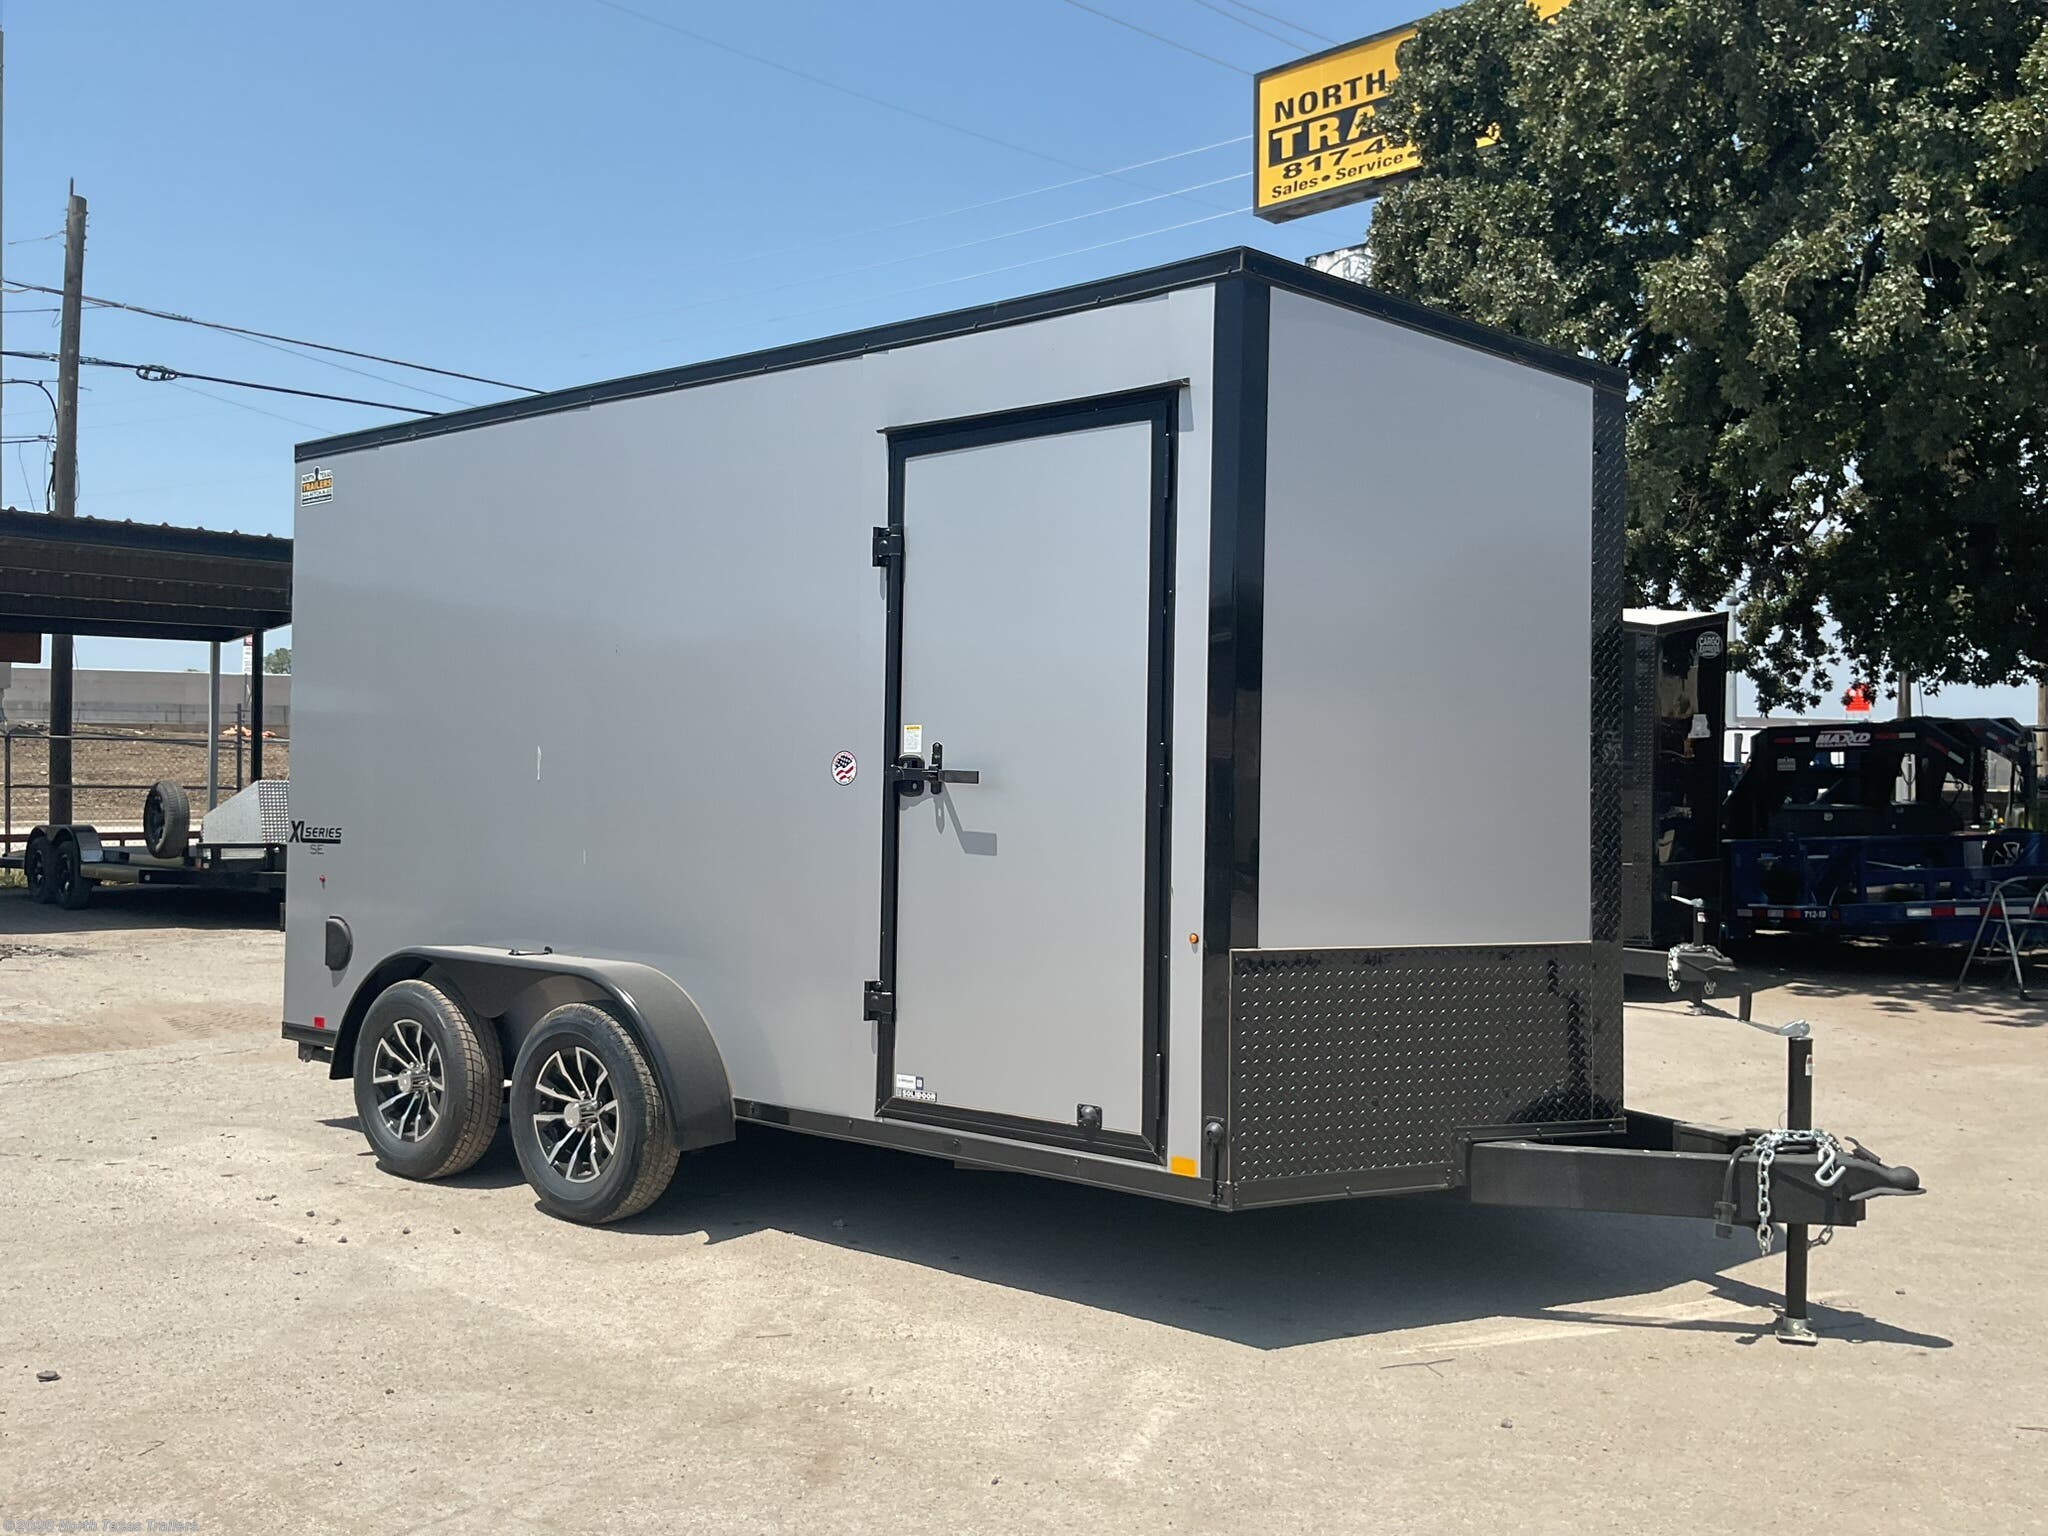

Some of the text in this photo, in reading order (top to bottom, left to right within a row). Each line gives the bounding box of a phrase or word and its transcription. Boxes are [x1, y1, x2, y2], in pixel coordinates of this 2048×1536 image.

[1275, 69, 1385, 123] NORTH
[1272, 153, 1403, 198] Sales Service
[305, 827, 342, 838] SERIES
[310, 844, 325, 855] SE
